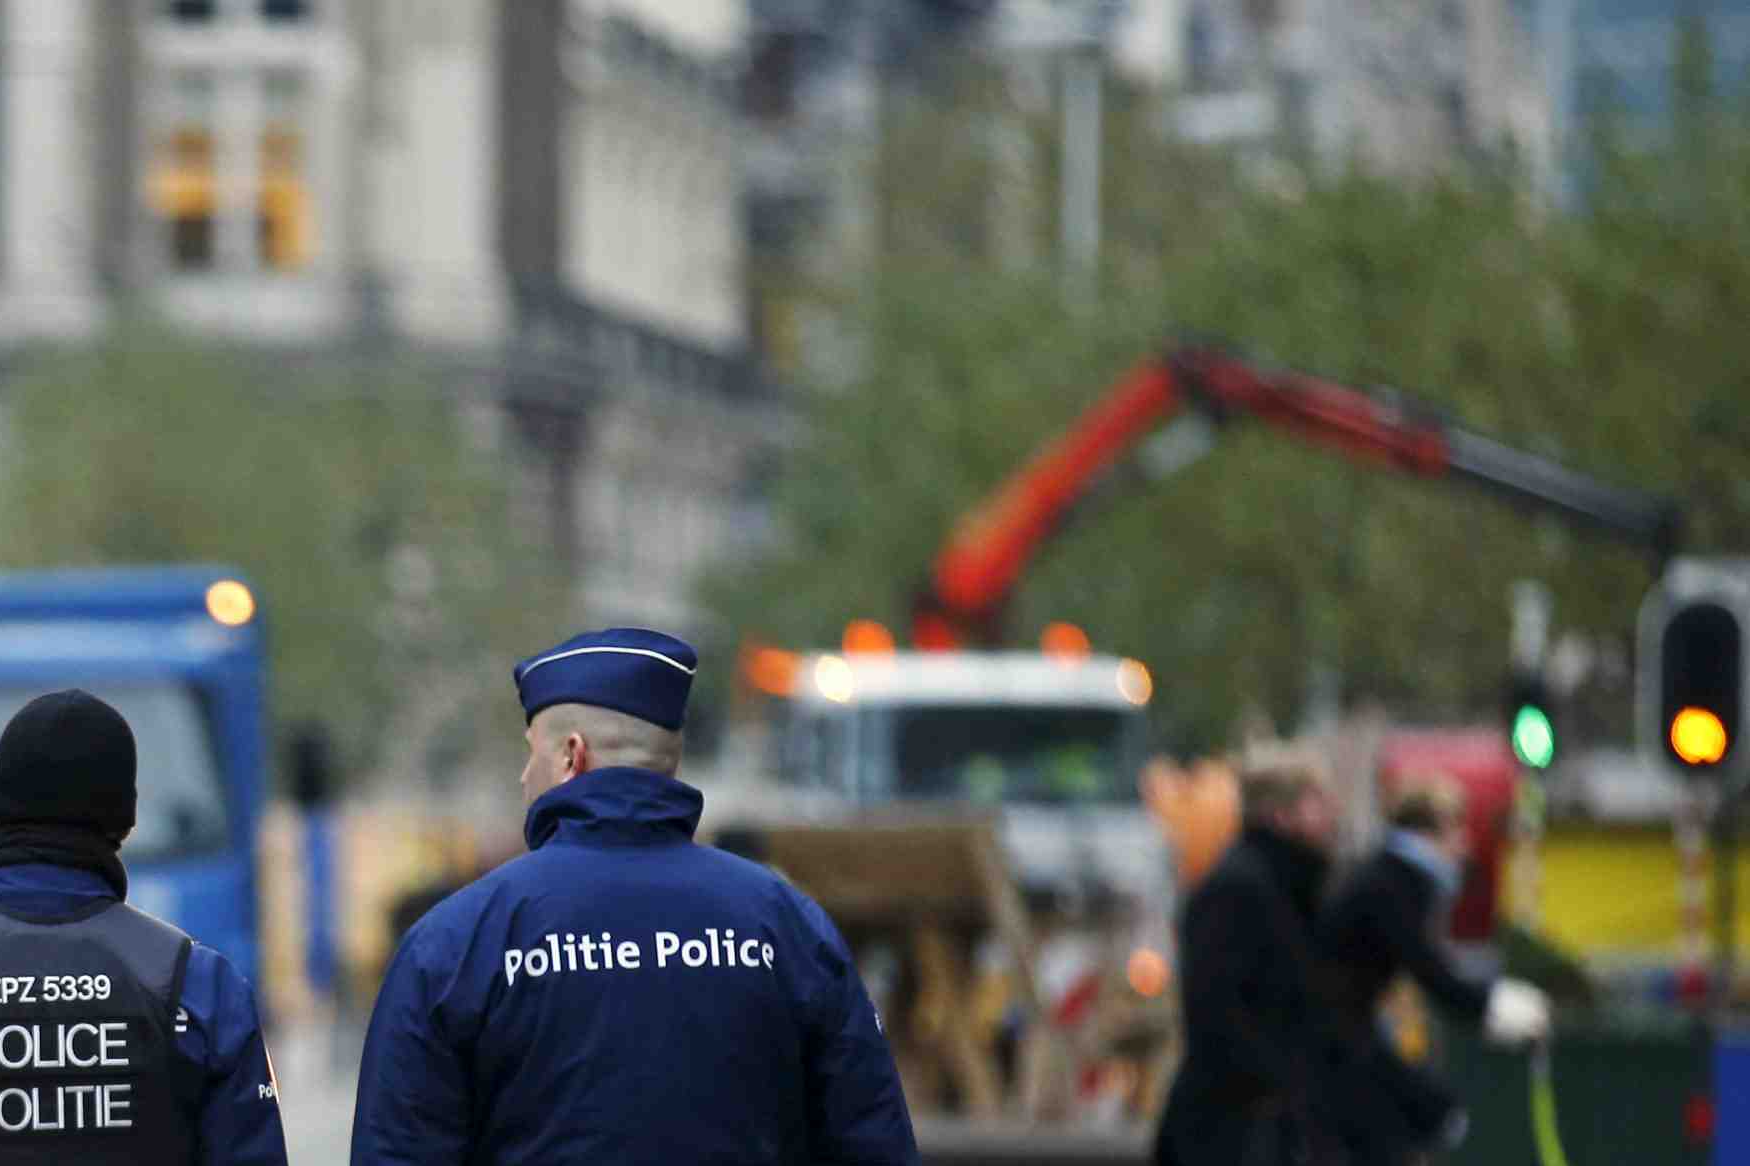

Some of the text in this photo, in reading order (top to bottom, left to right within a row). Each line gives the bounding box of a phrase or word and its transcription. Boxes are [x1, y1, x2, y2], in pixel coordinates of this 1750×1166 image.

[505, 928, 774, 986] Politie Police
[42, 974, 111, 1002] 5339
